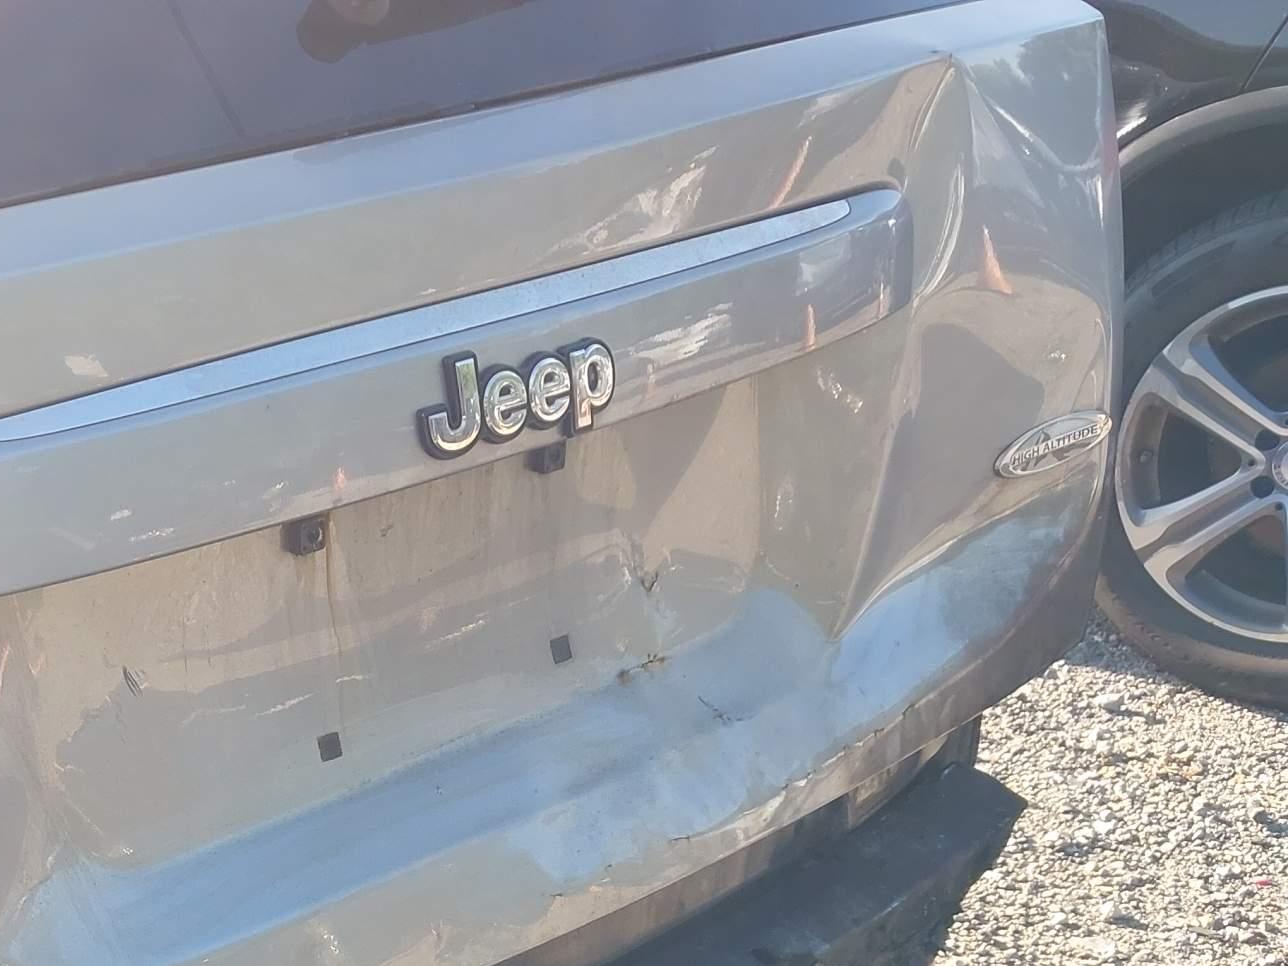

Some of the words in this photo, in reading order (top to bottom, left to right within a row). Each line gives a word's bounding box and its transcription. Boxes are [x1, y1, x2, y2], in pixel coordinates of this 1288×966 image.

[416, 337, 615, 460] Jeep
[1011, 445, 1040, 466] HIGH
[1042, 423, 1099, 452] ALTITUDE
